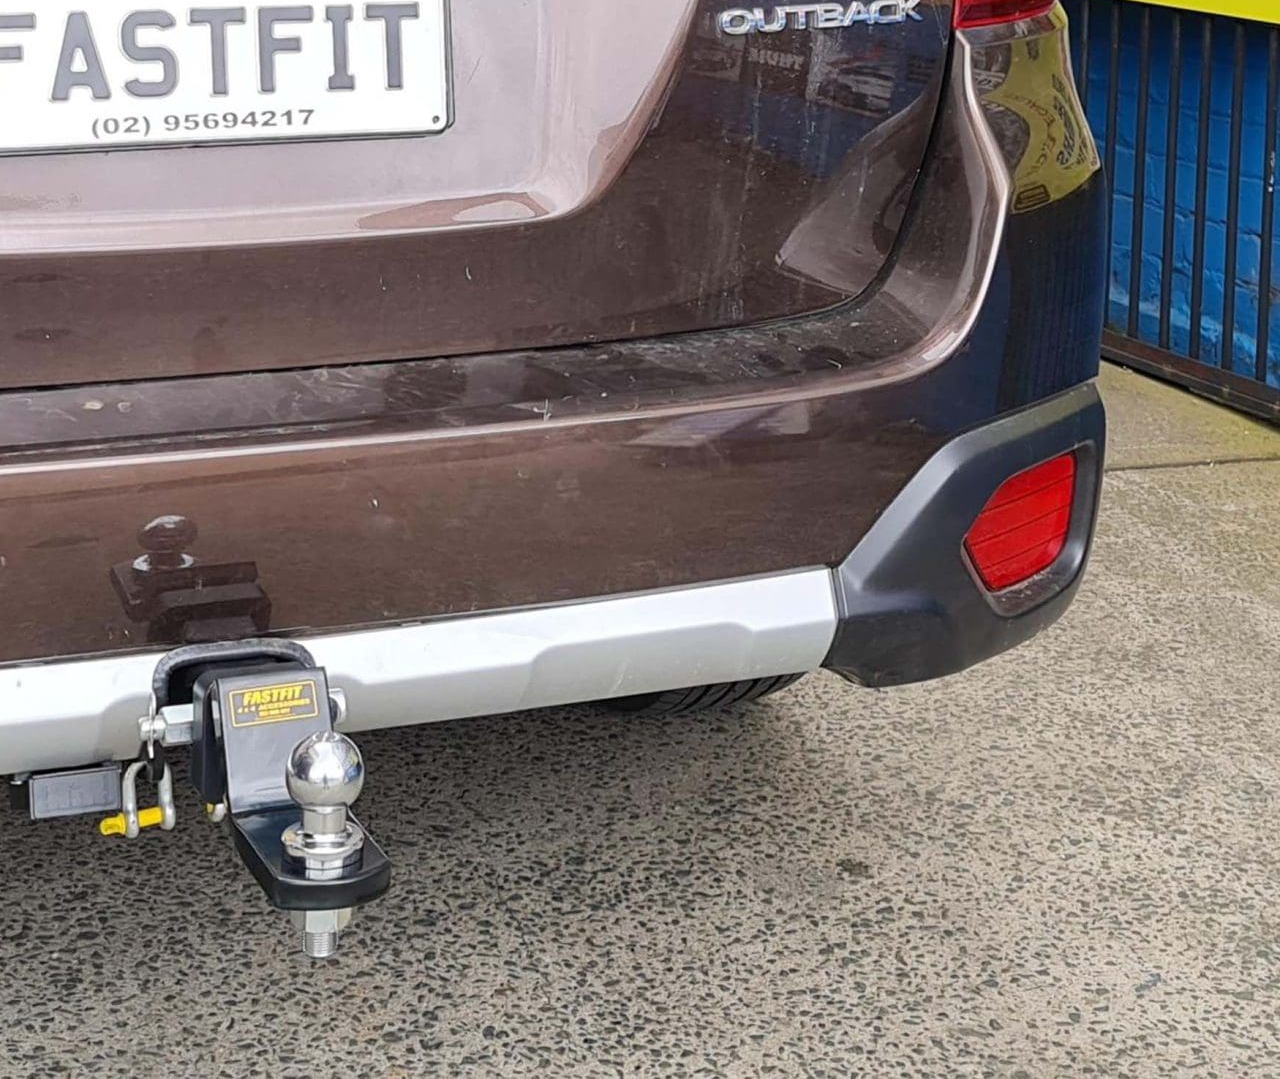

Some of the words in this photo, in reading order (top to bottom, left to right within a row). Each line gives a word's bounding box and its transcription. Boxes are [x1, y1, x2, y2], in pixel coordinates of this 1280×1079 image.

[91, 115, 151, 139] (02)
[163, 108, 315, 132] 95694217
[242, 685, 304, 707] FASTFIT
